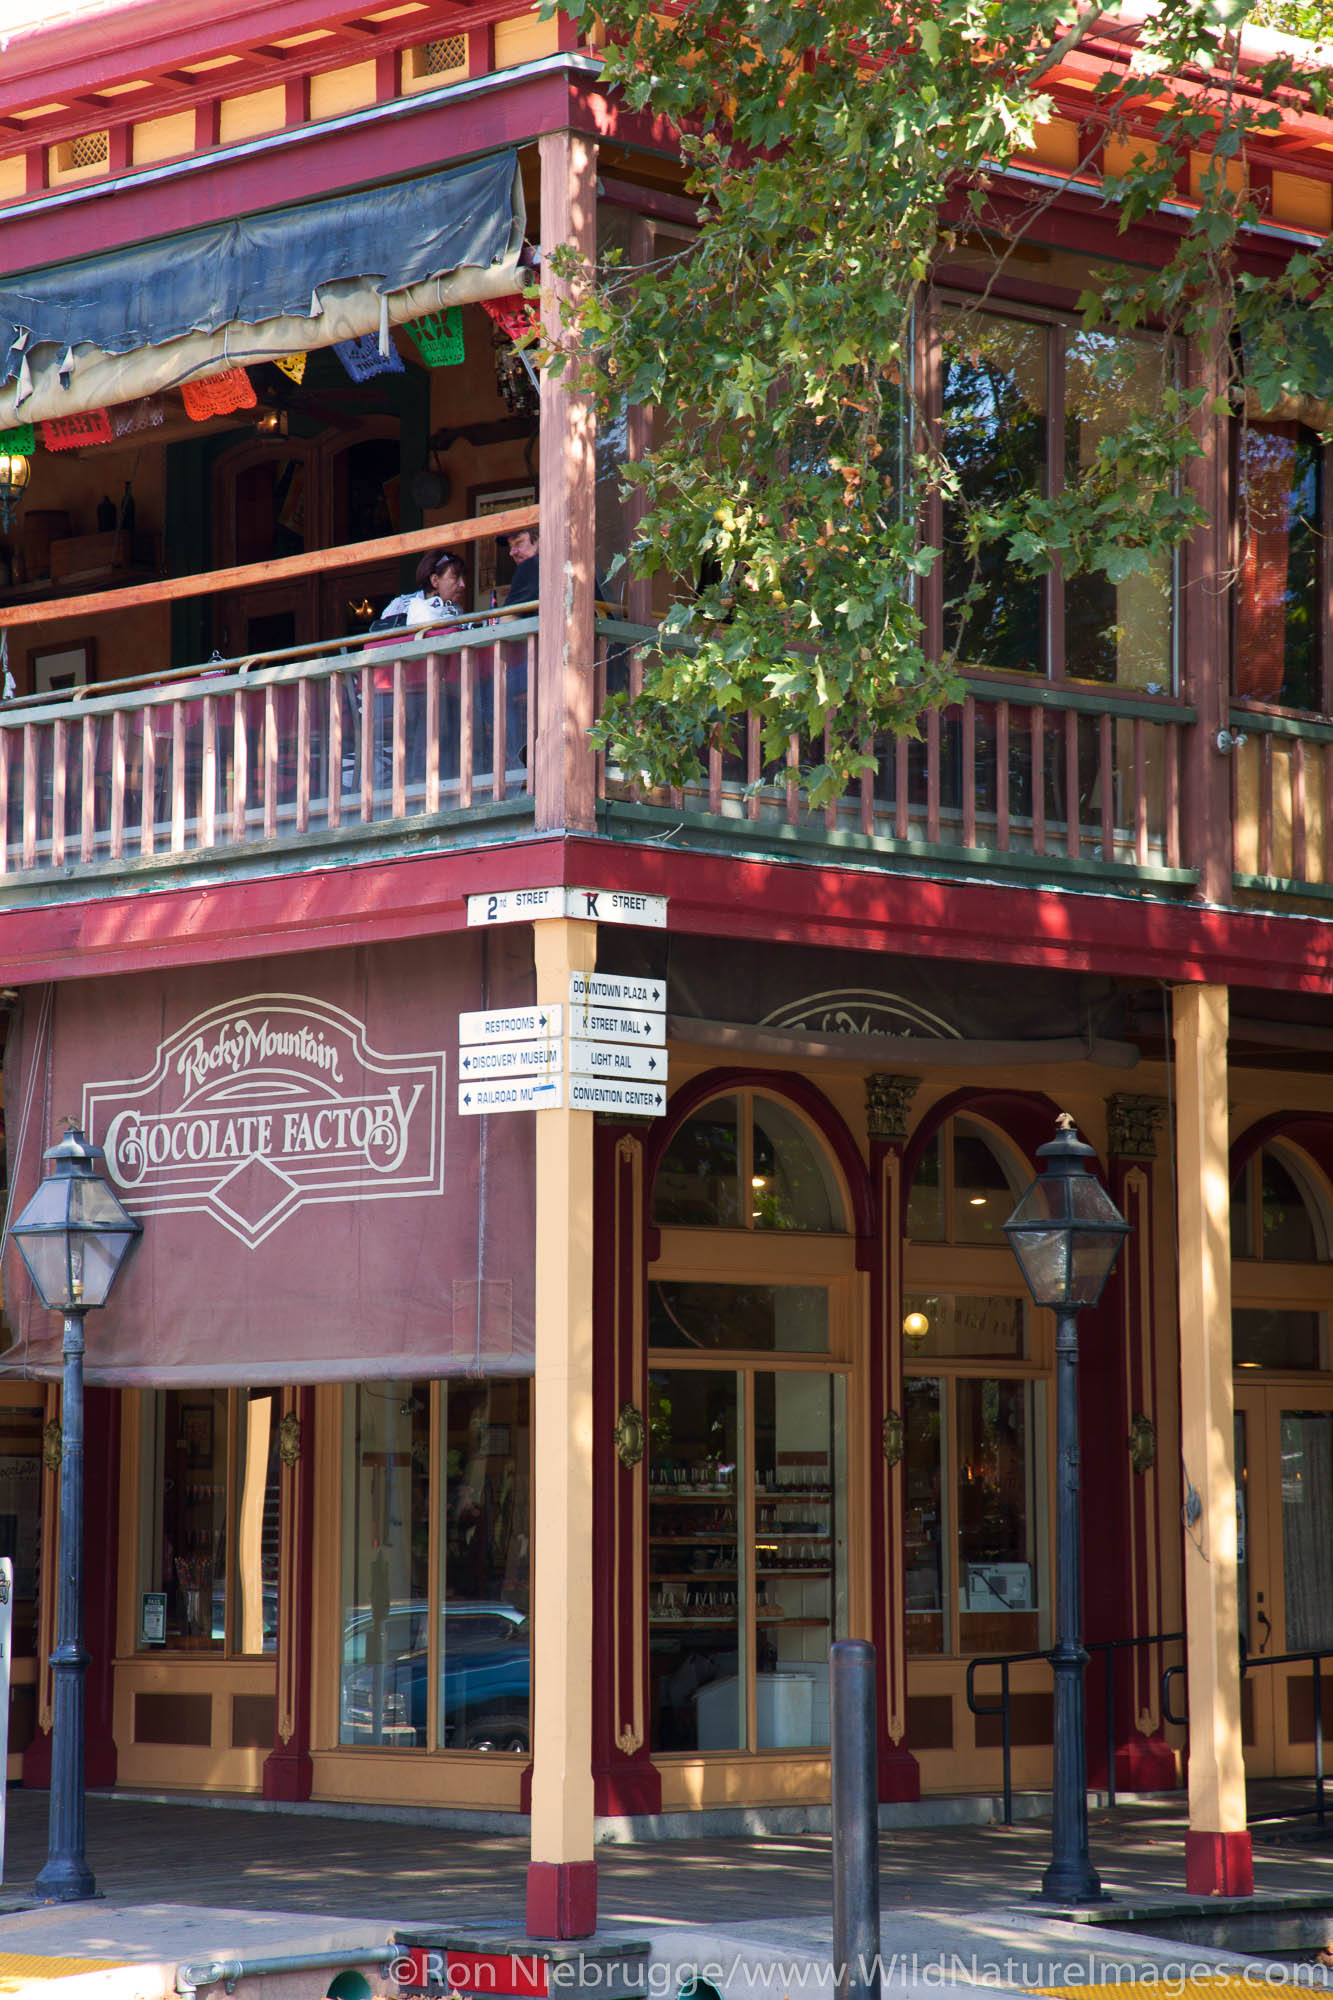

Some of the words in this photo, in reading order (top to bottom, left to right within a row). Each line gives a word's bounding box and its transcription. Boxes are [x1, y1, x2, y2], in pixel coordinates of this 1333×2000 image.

[515, 890, 549, 906] STREET
[586, 892, 599, 917] K
[611, 895, 647, 911] STREET
[573, 980, 621, 999] DOWNTOWN
[623, 985, 648, 1001] PLAZA
[485, 1016, 535, 1033] RESTROOMS
[582, 1016, 588, 1029] K
[591, 1017, 618, 1031] STREET
[620, 1020, 641, 1034] MALL
[177, 1023, 243, 1098] Rocky
[234, 1019, 344, 1083] Mountain
[472, 1052, 517, 1069] DISCOVERY
[520, 1050, 557, 1065] MUSEUM
[590, 1052, 612, 1067] LIGHT
[614, 1055, 632, 1069] RAIL
[477, 1089, 517, 1105] RAILROAD
[573, 1087, 622, 1104] CONVENTION
[624, 1089, 654, 1105] CENTER
[102, 1110, 273, 1188] CHOCOLATE
[282, 1084, 425, 1173] FACTORY
